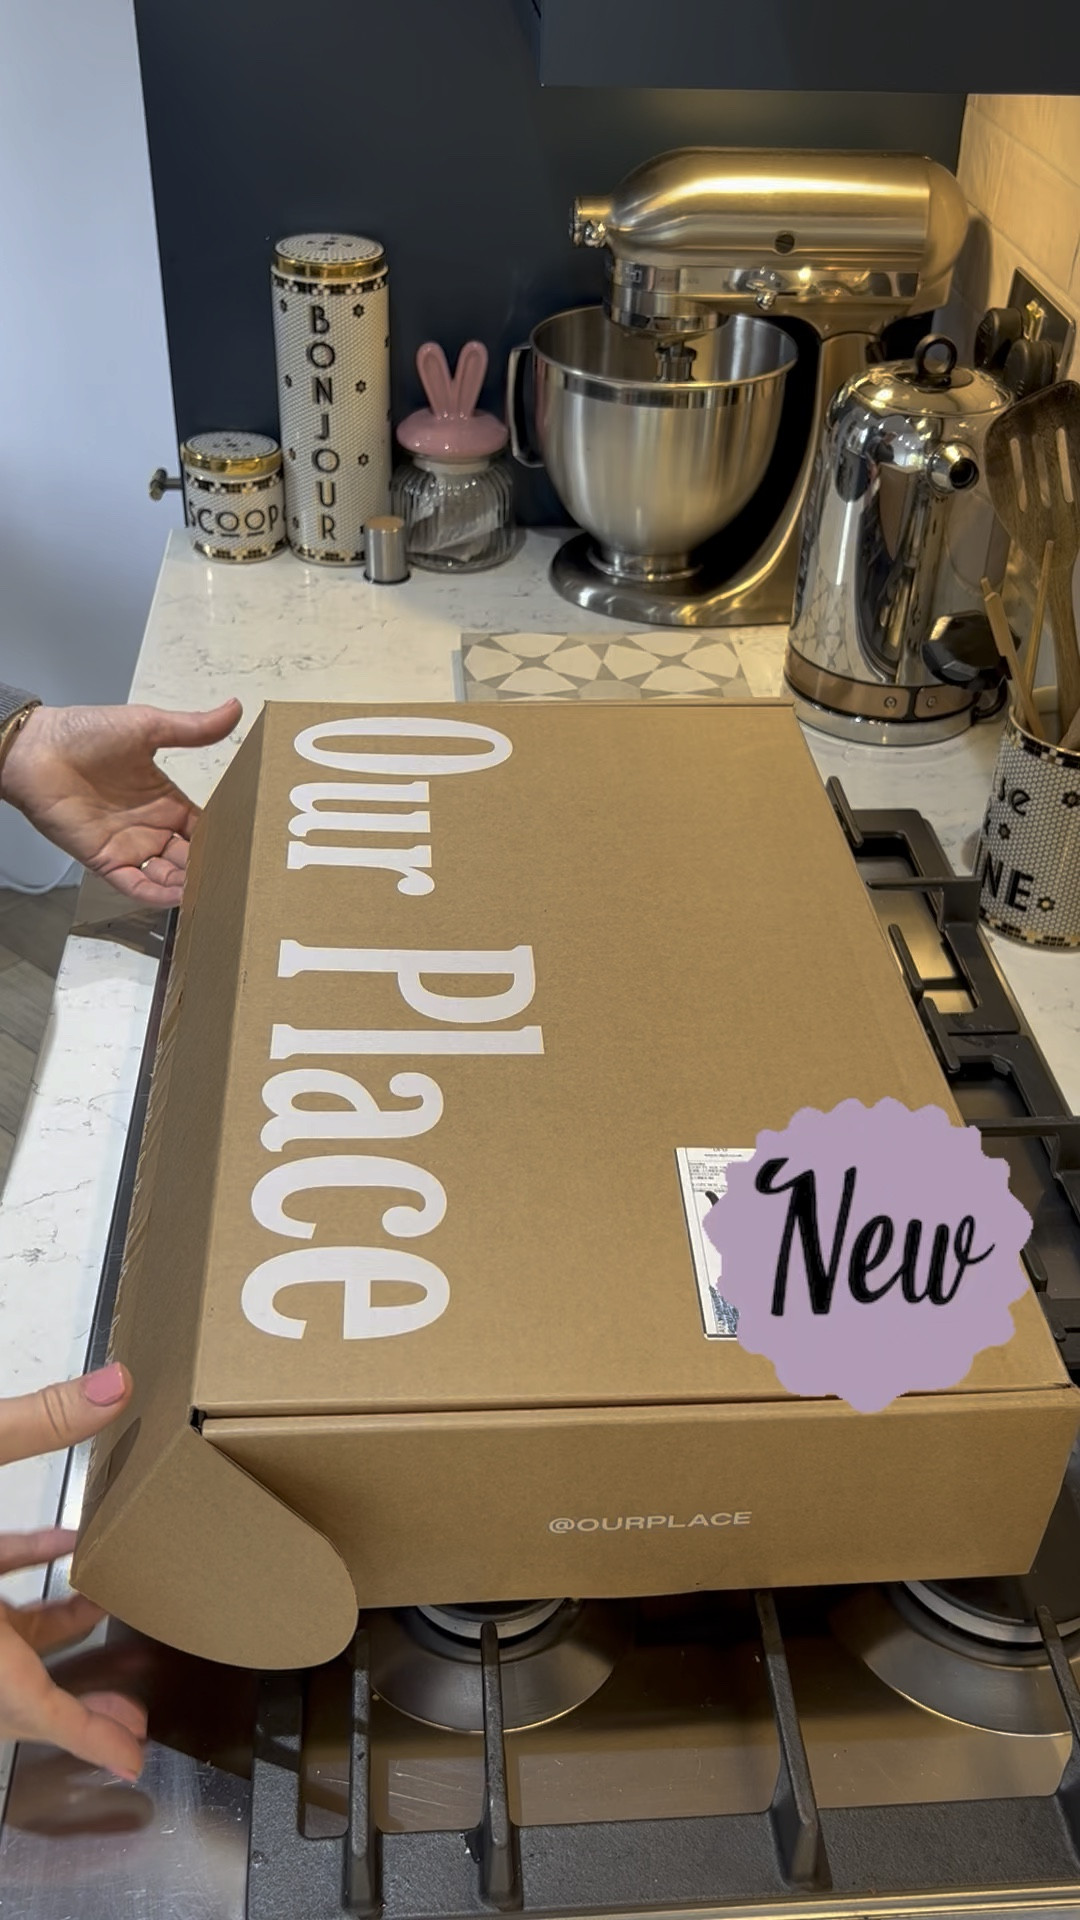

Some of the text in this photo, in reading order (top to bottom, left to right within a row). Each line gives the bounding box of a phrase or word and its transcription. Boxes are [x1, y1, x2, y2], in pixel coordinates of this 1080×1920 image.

[306, 304, 340, 542] BONJOUR
[241, 716, 545, 1341] Our Place
[548, 1511, 753, 1534] @OURPLACE
